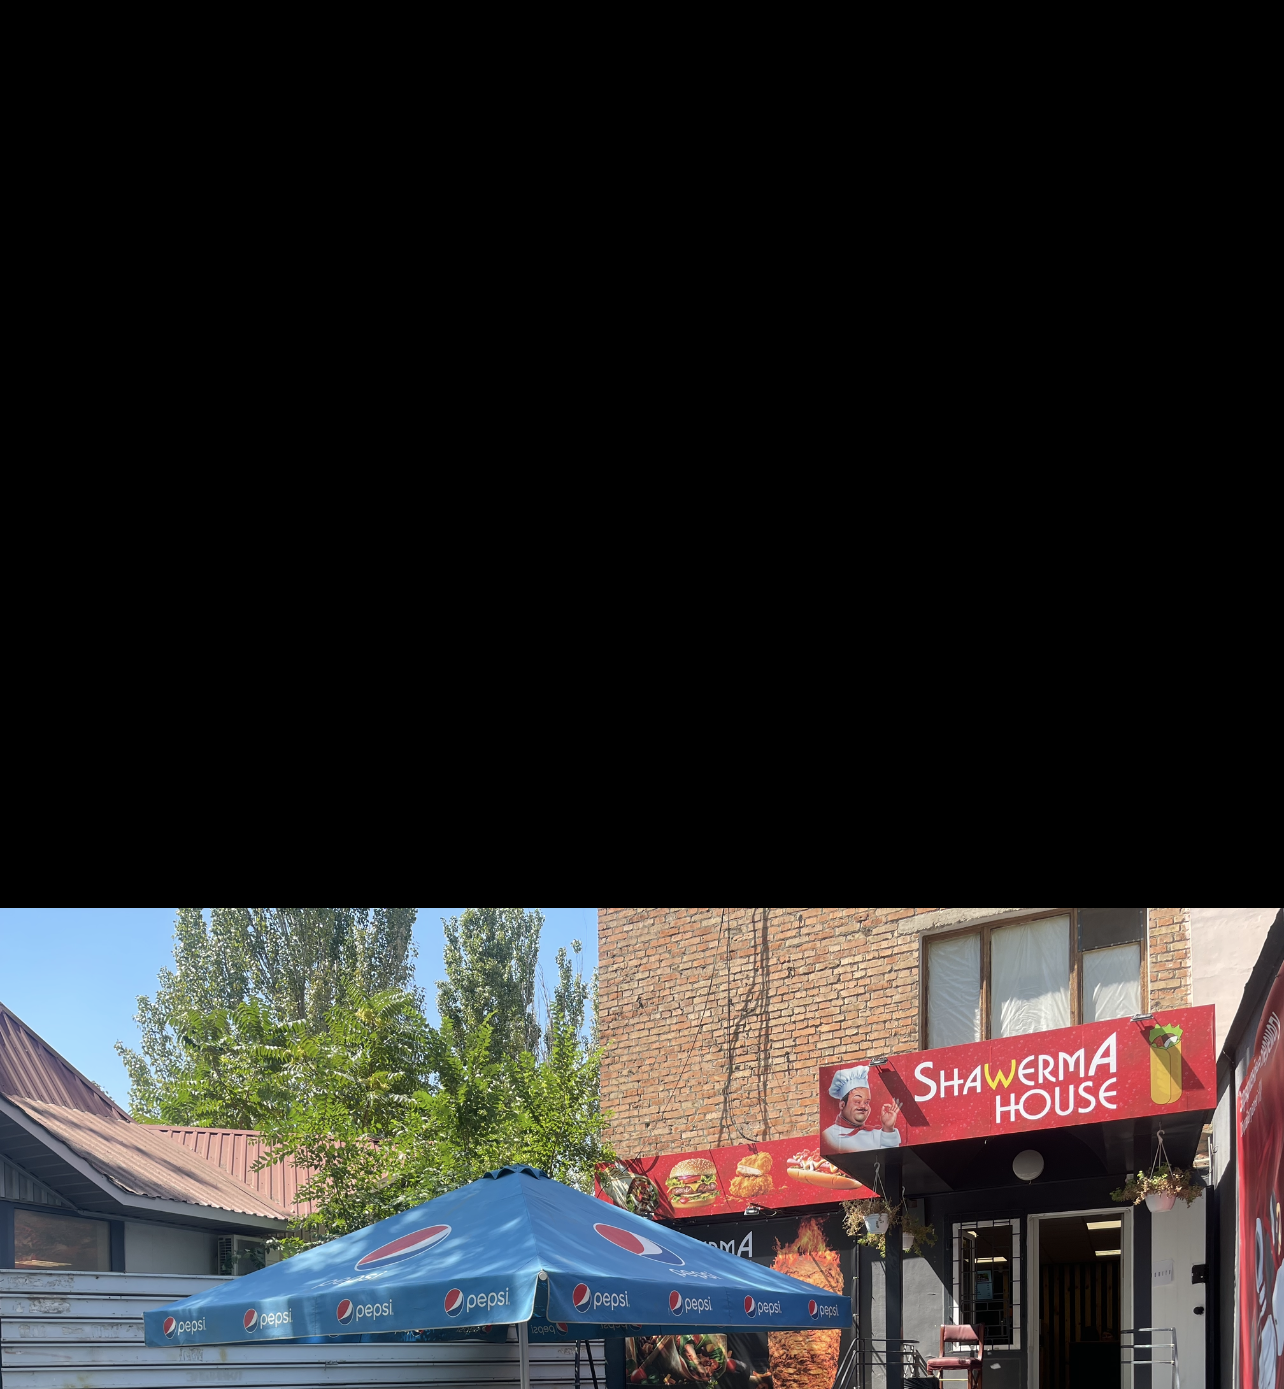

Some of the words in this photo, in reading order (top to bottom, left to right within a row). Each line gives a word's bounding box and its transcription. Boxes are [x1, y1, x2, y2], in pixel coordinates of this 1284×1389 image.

[914, 1032, 1117, 1102] SHAWERMA
[995, 1077, 1117, 1124] HOUSE
[356, 1299, 394, 1321] pepsi
[466, 1287, 510, 1312] pepsi
[593, 1290, 630, 1311] pepsi
[684, 1297, 712, 1313] pepsi
[757, 1300, 782, 1316] pepsi
[260, 1308, 293, 1329] pepsi
[819, 1303, 839, 1319] pepsi
[177, 1317, 207, 1335] pepsi
